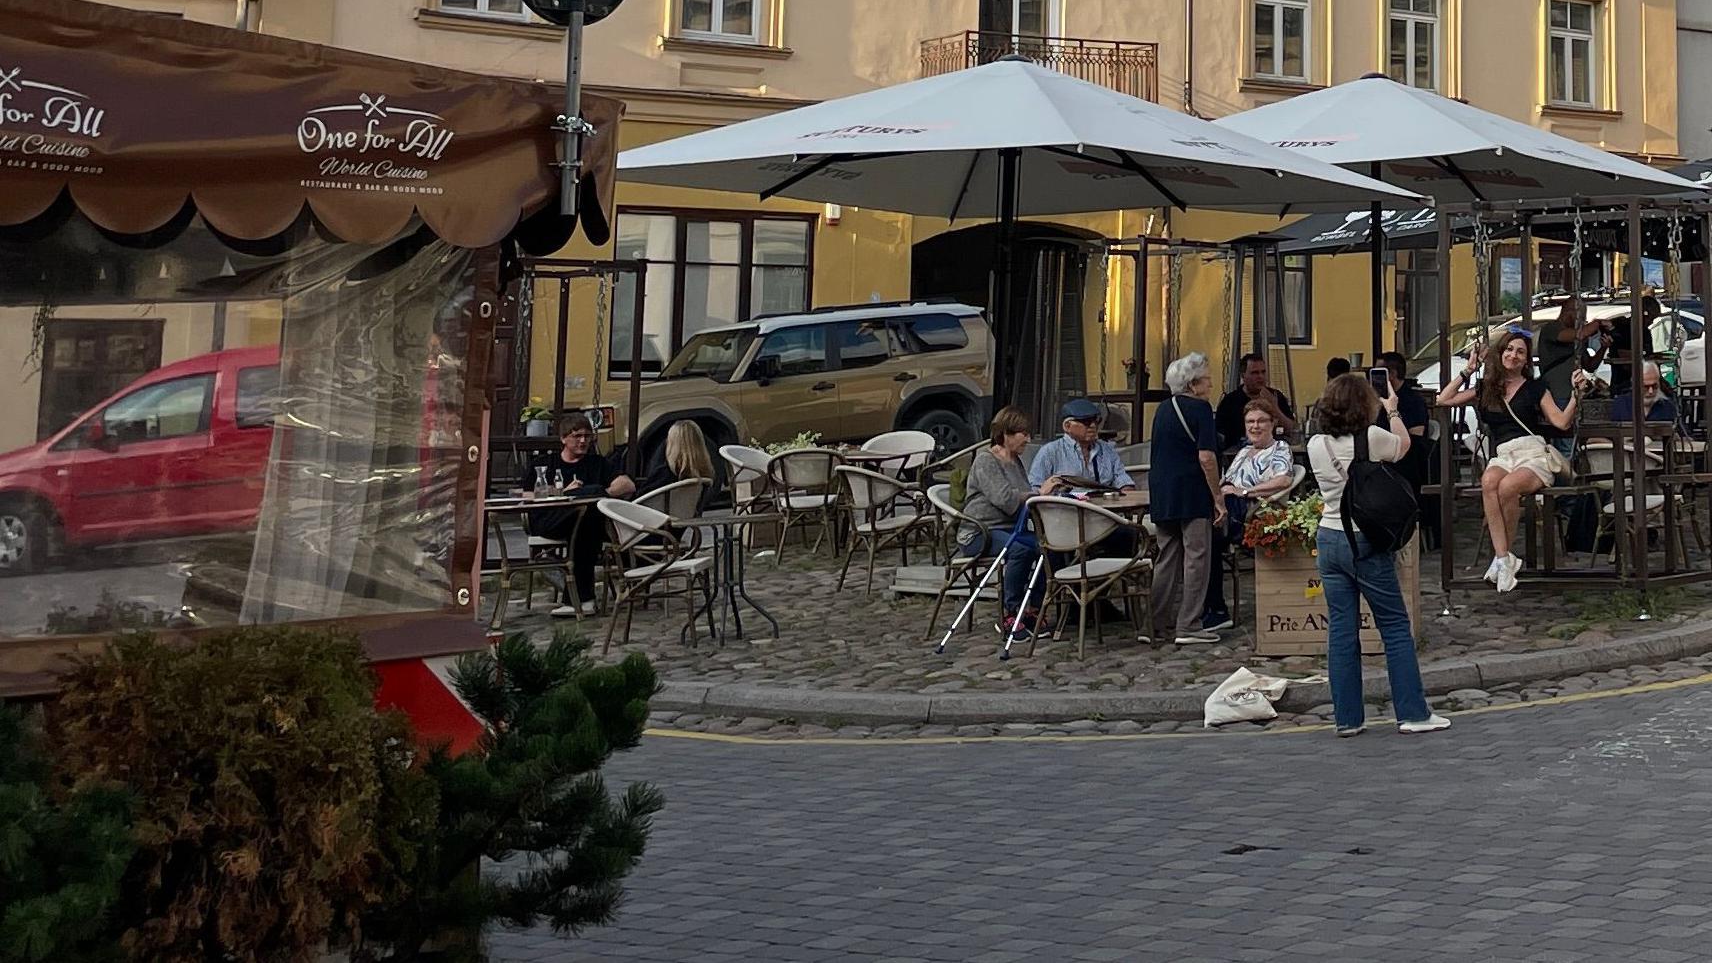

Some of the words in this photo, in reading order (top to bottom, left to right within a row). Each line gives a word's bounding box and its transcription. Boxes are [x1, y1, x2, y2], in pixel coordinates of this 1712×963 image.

[41, 97, 104, 137] All
[22, 134, 90, 157] Cuisine
[297, 117, 357, 153] One
[359, 119, 395, 153] for
[399, 120, 455, 161] All
[319, 157, 374, 176] World
[374, 160, 428, 180] Cuisine
[300, 180, 352, 189] RESTAURANT
[1266, 614, 1299, 633] Prie
